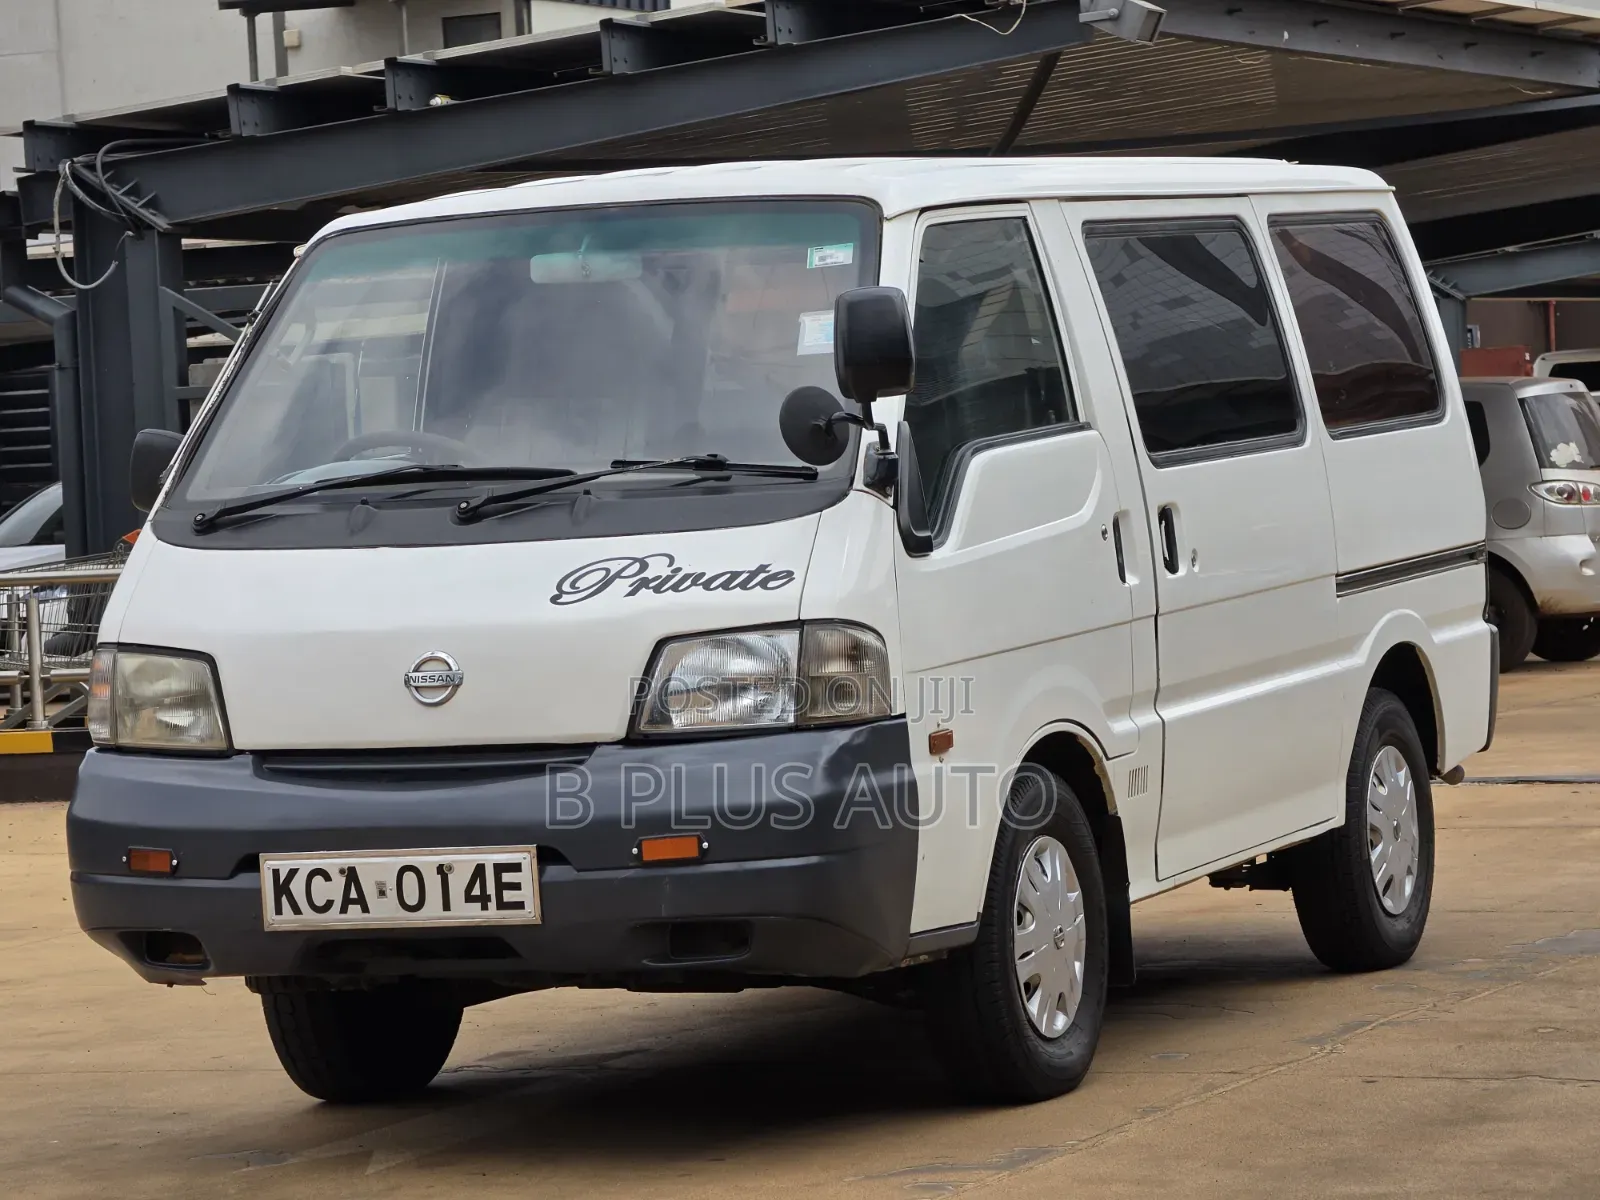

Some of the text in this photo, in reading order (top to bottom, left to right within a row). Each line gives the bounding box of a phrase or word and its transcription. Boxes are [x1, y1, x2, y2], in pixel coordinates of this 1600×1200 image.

[550, 553, 795, 605] Private
[410, 674, 455, 684] NISSAN
[271, 862, 526, 916] KCA 014E
